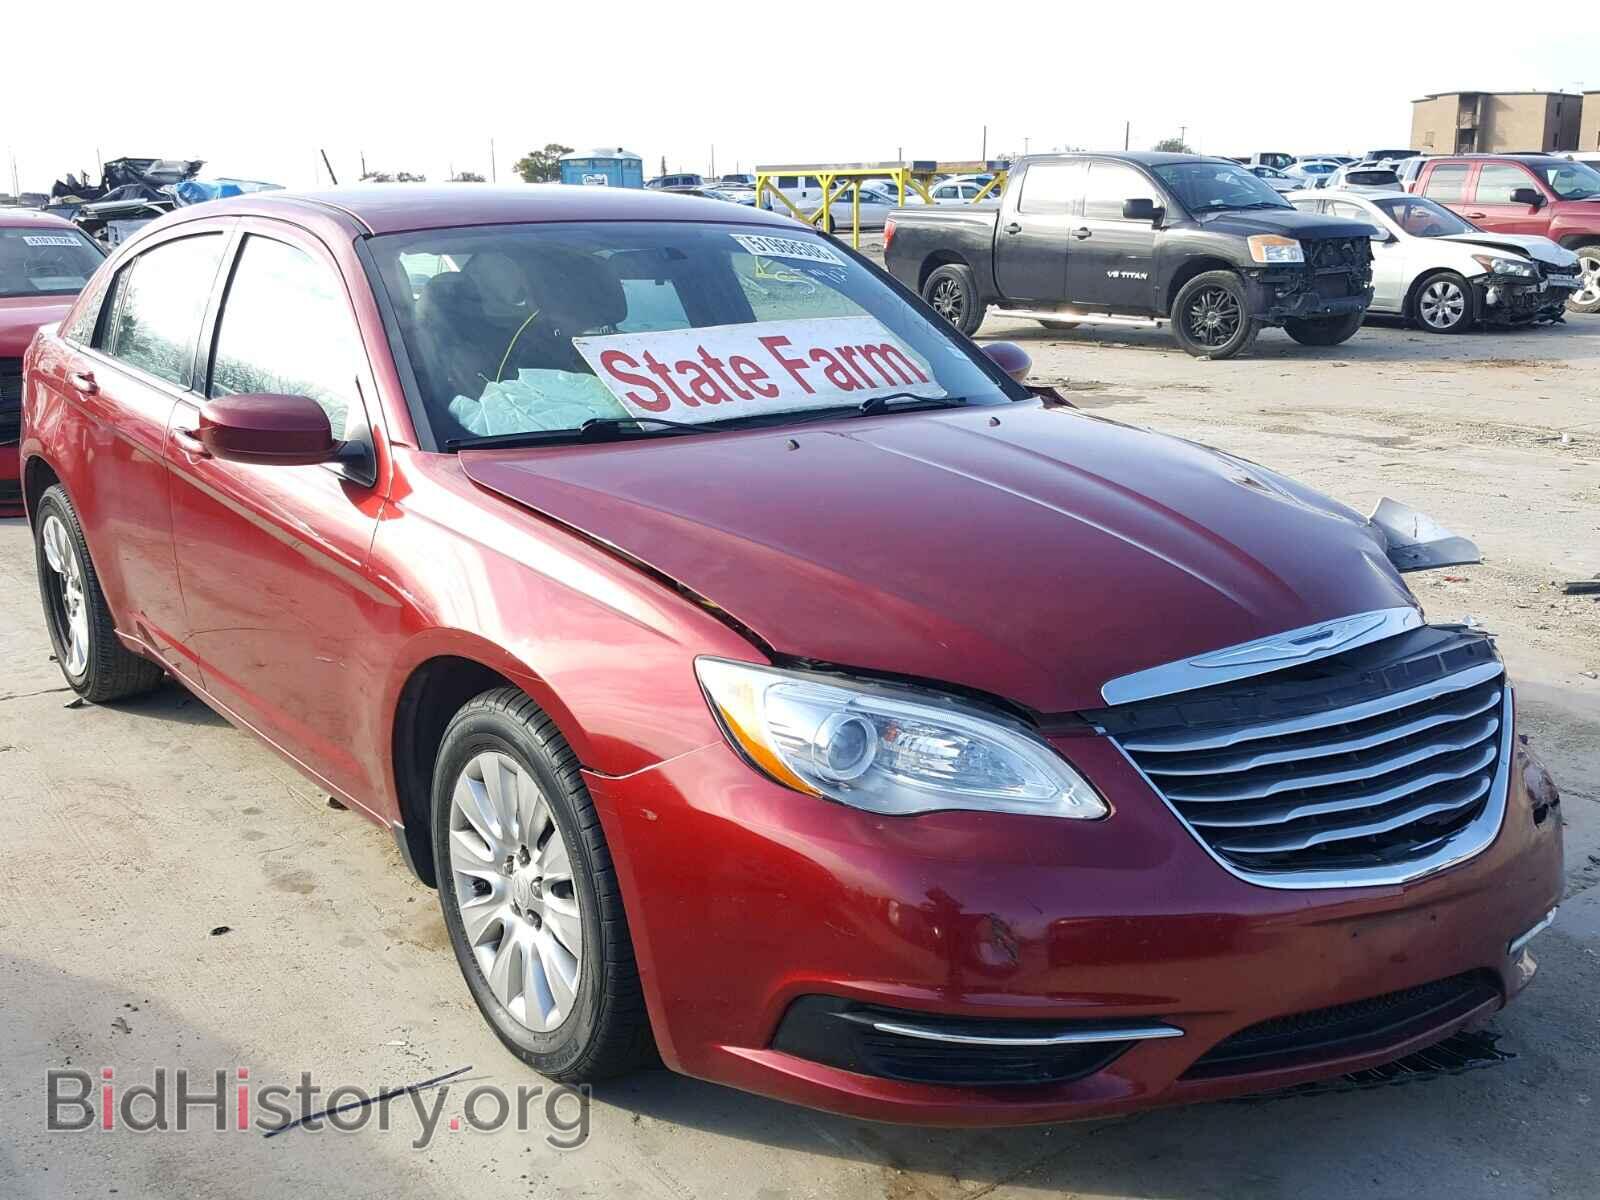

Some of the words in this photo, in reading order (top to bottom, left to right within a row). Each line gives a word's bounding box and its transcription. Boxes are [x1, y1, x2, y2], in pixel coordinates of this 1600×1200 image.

[1107, 270, 1119, 278] V8
[1120, 271, 1148, 280] TITAN
[599, 344, 780, 413] State
[757, 335, 930, 395] Farm
